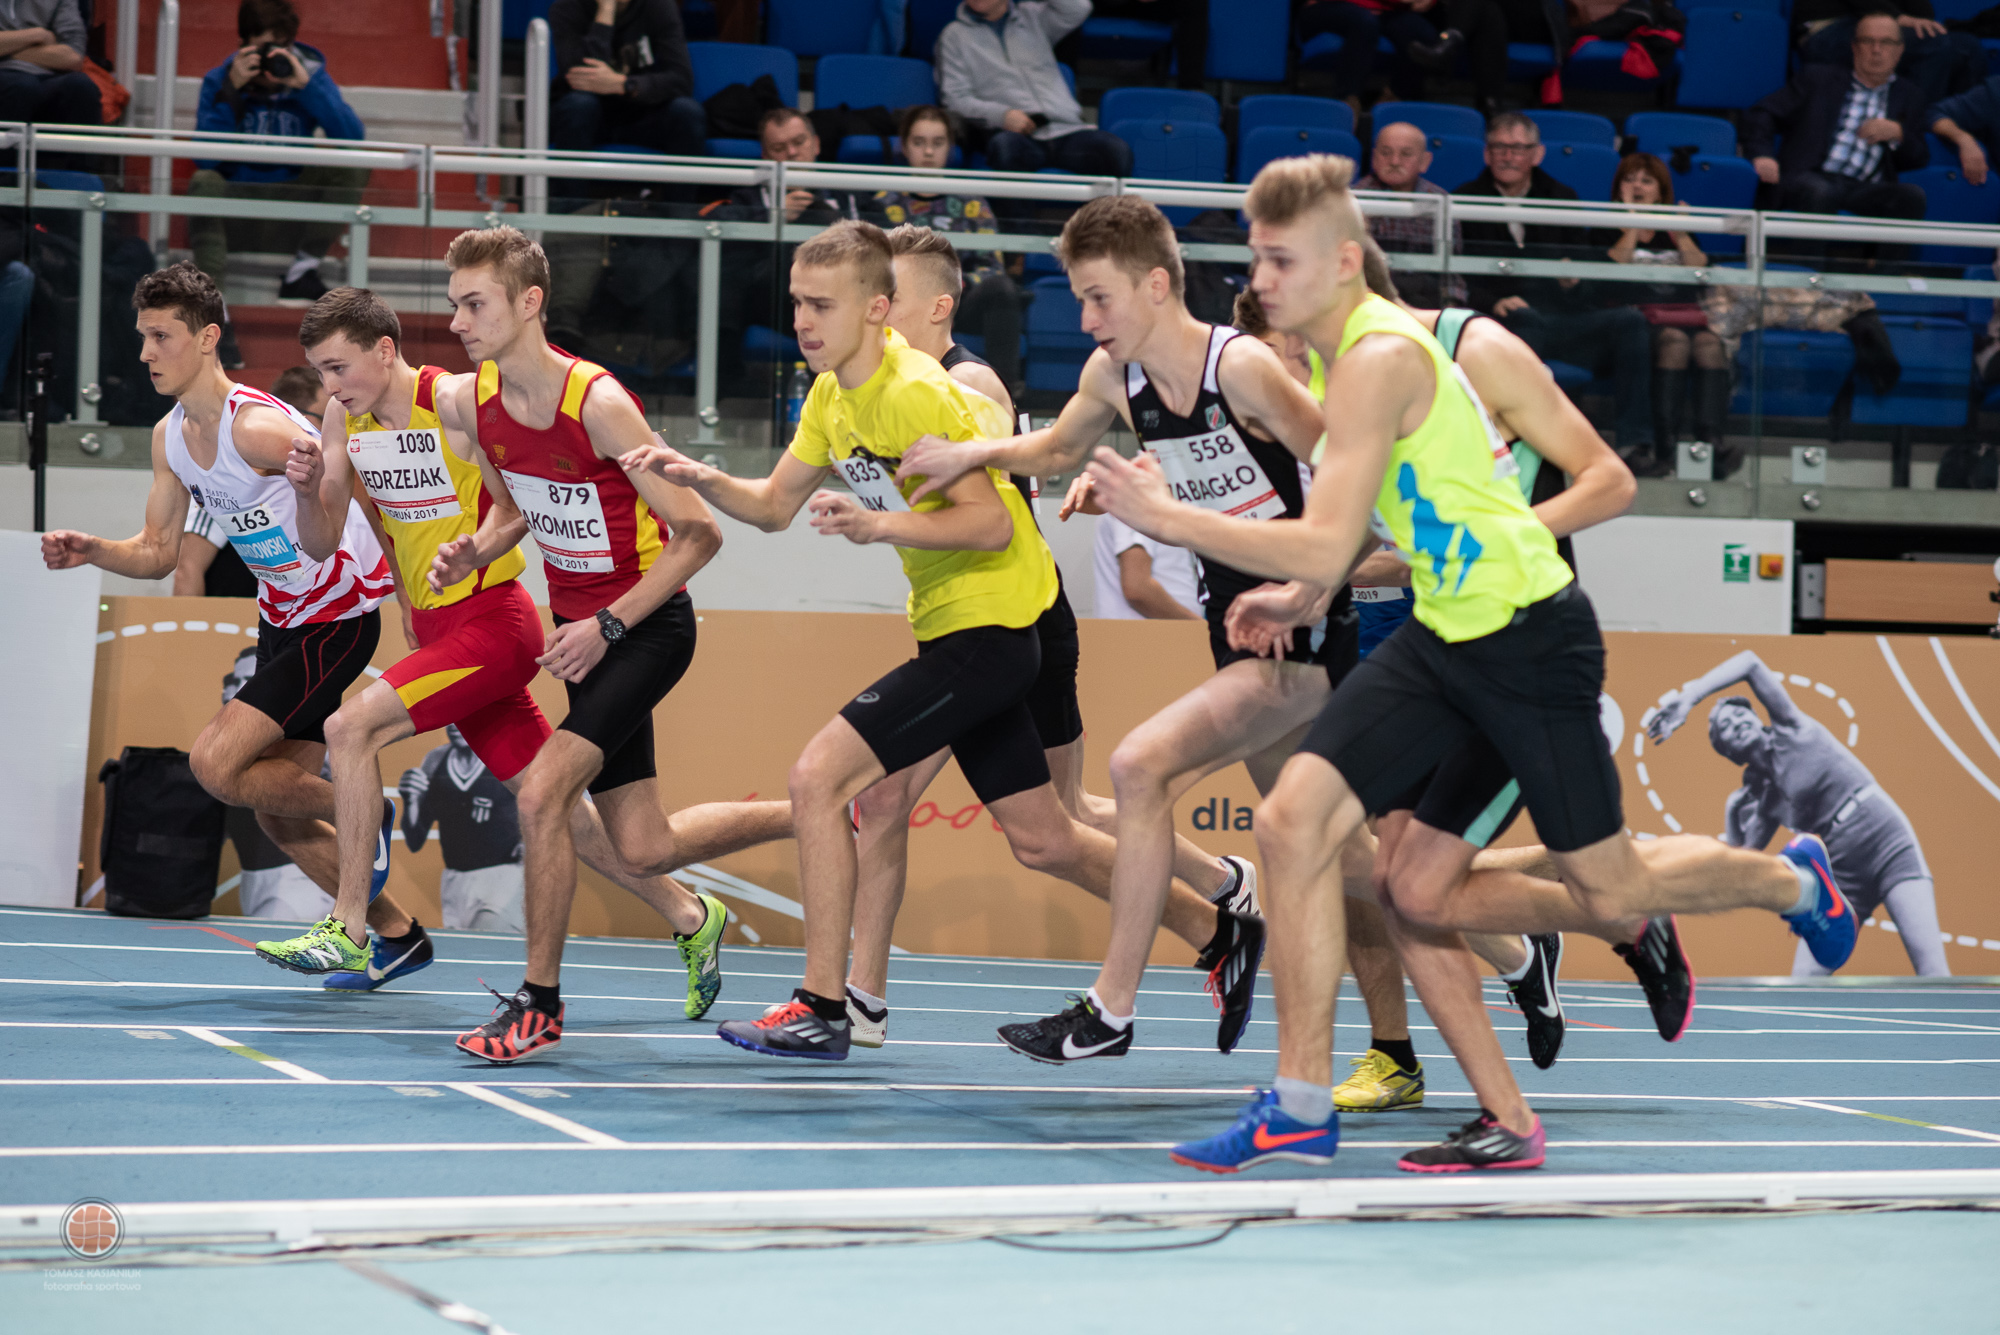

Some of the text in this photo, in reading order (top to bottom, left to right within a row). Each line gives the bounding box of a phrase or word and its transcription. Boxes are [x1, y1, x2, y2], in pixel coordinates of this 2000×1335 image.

[395, 432, 436, 454] 1030
[1189, 434, 1235, 463] 558
[845, 461, 881, 483] 835
[548, 483, 590, 506] 879
[1168, 465, 1256, 502] ABAGŁO
[231, 509, 271, 533] 163
[413, 508, 439, 520] 2019
[565, 559, 589, 570] 2019
[1355, 590, 1379, 600] 2019
[1192, 797, 1254, 831] dla
